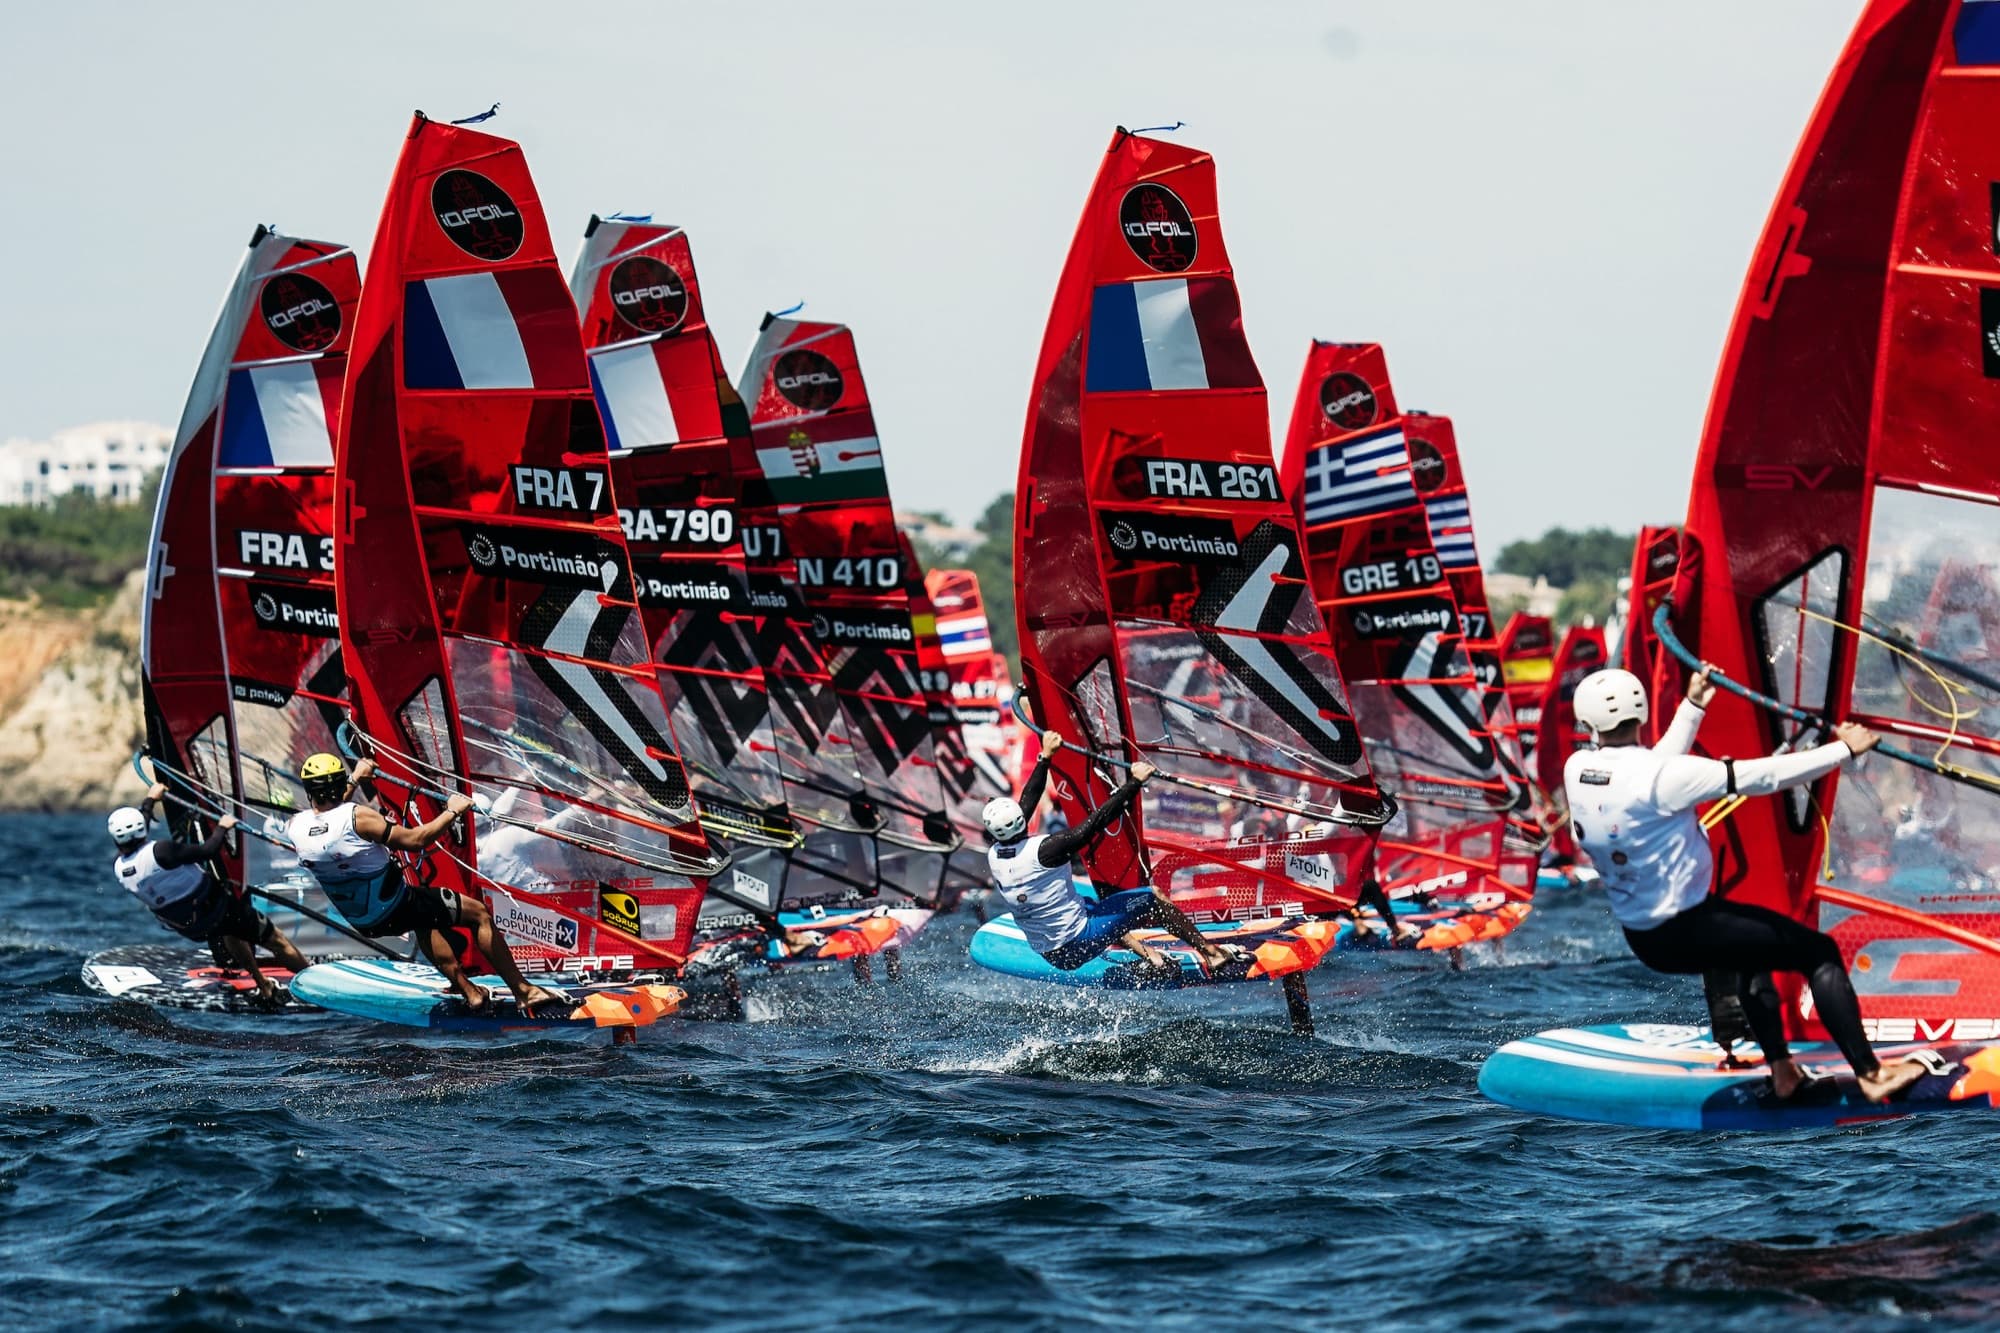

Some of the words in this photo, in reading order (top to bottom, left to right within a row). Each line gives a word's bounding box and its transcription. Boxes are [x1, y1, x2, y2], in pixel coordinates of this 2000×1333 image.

[514, 467, 579, 510] FRA
[586, 472, 604, 511] 7
[1146, 461, 1212, 497] FRA
[1218, 465, 1278, 499] 261
[617, 508, 733, 543] RA-790
[240, 531, 309, 569] FRA
[742, 527, 762, 557] U
[767, 527, 781, 557] 7
[1141, 530, 1239, 557] Portimão
[500, 545, 599, 577] Portimão
[833, 558, 898, 587] 410
[1343, 561, 1399, 595] GRE
[1404, 555, 1441, 584] 19
[647, 579, 730, 600] Portimão
[752, 591, 788, 608] imão
[281, 602, 339, 629] Portim
[832, 621, 912, 641] Portimão
[1237, 828, 1324, 846] GLIDE
[1289, 855, 1329, 881] ATOUT
[495, 914, 554, 944] POPULAIRE
[510, 909, 554, 932] BANQUE
